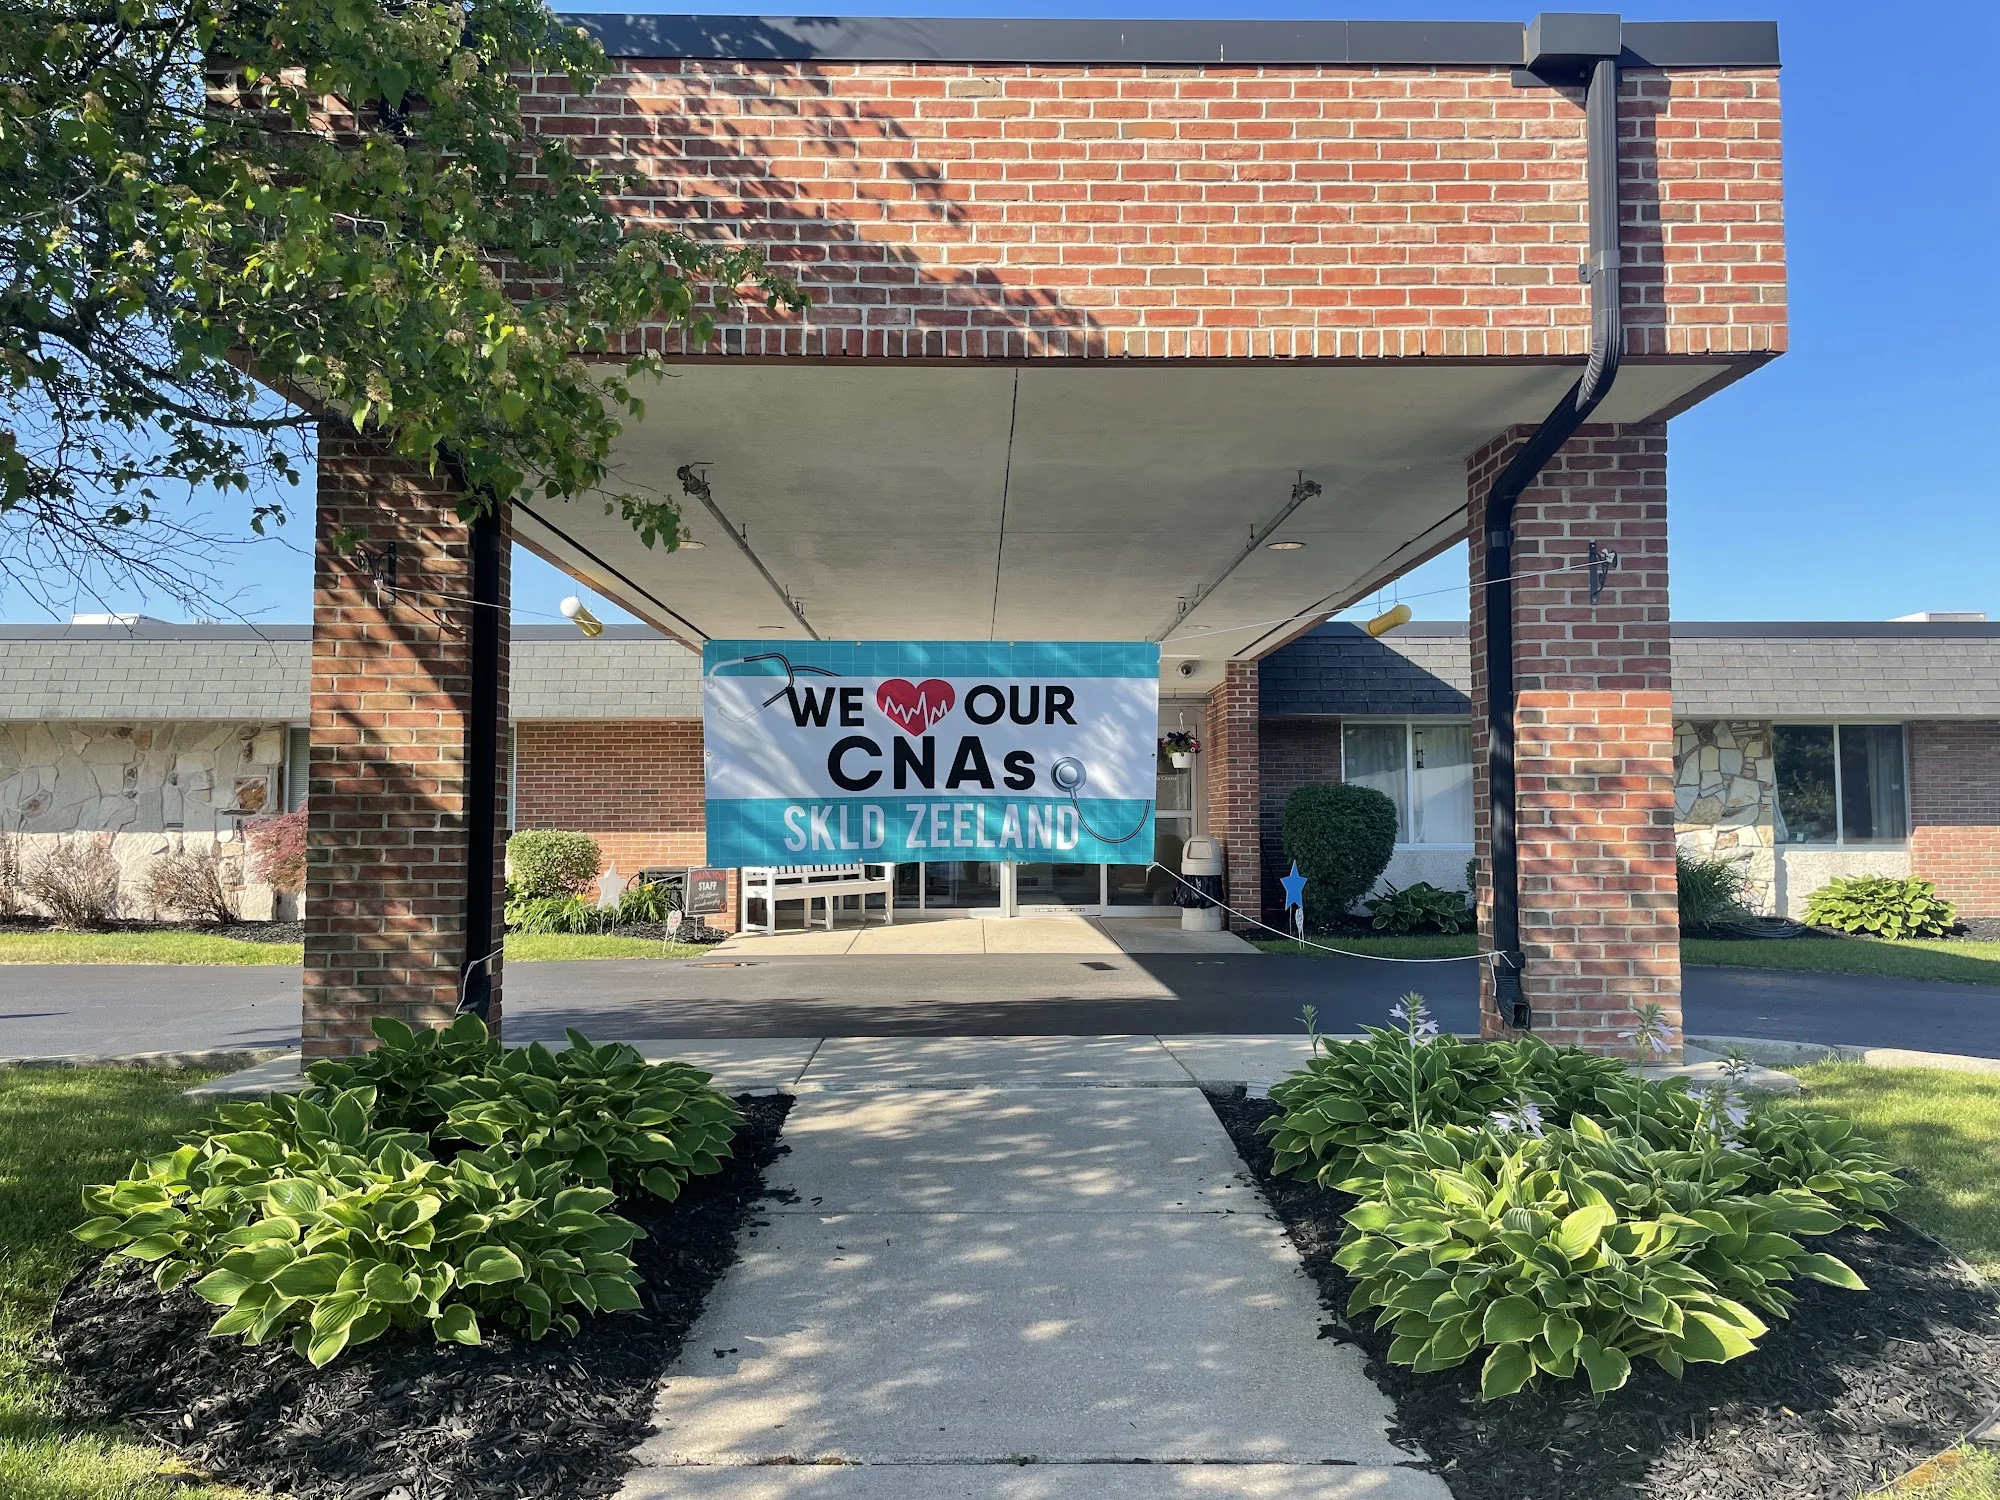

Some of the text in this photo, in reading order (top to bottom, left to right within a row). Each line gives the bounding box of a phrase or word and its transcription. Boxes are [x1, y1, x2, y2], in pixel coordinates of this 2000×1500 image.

[785, 684, 1078, 727] WE OUR
[827, 735, 1036, 791] CNAs
[783, 803, 1079, 852] SKLD ZEELAND
[698, 881, 717, 891] STAFF
